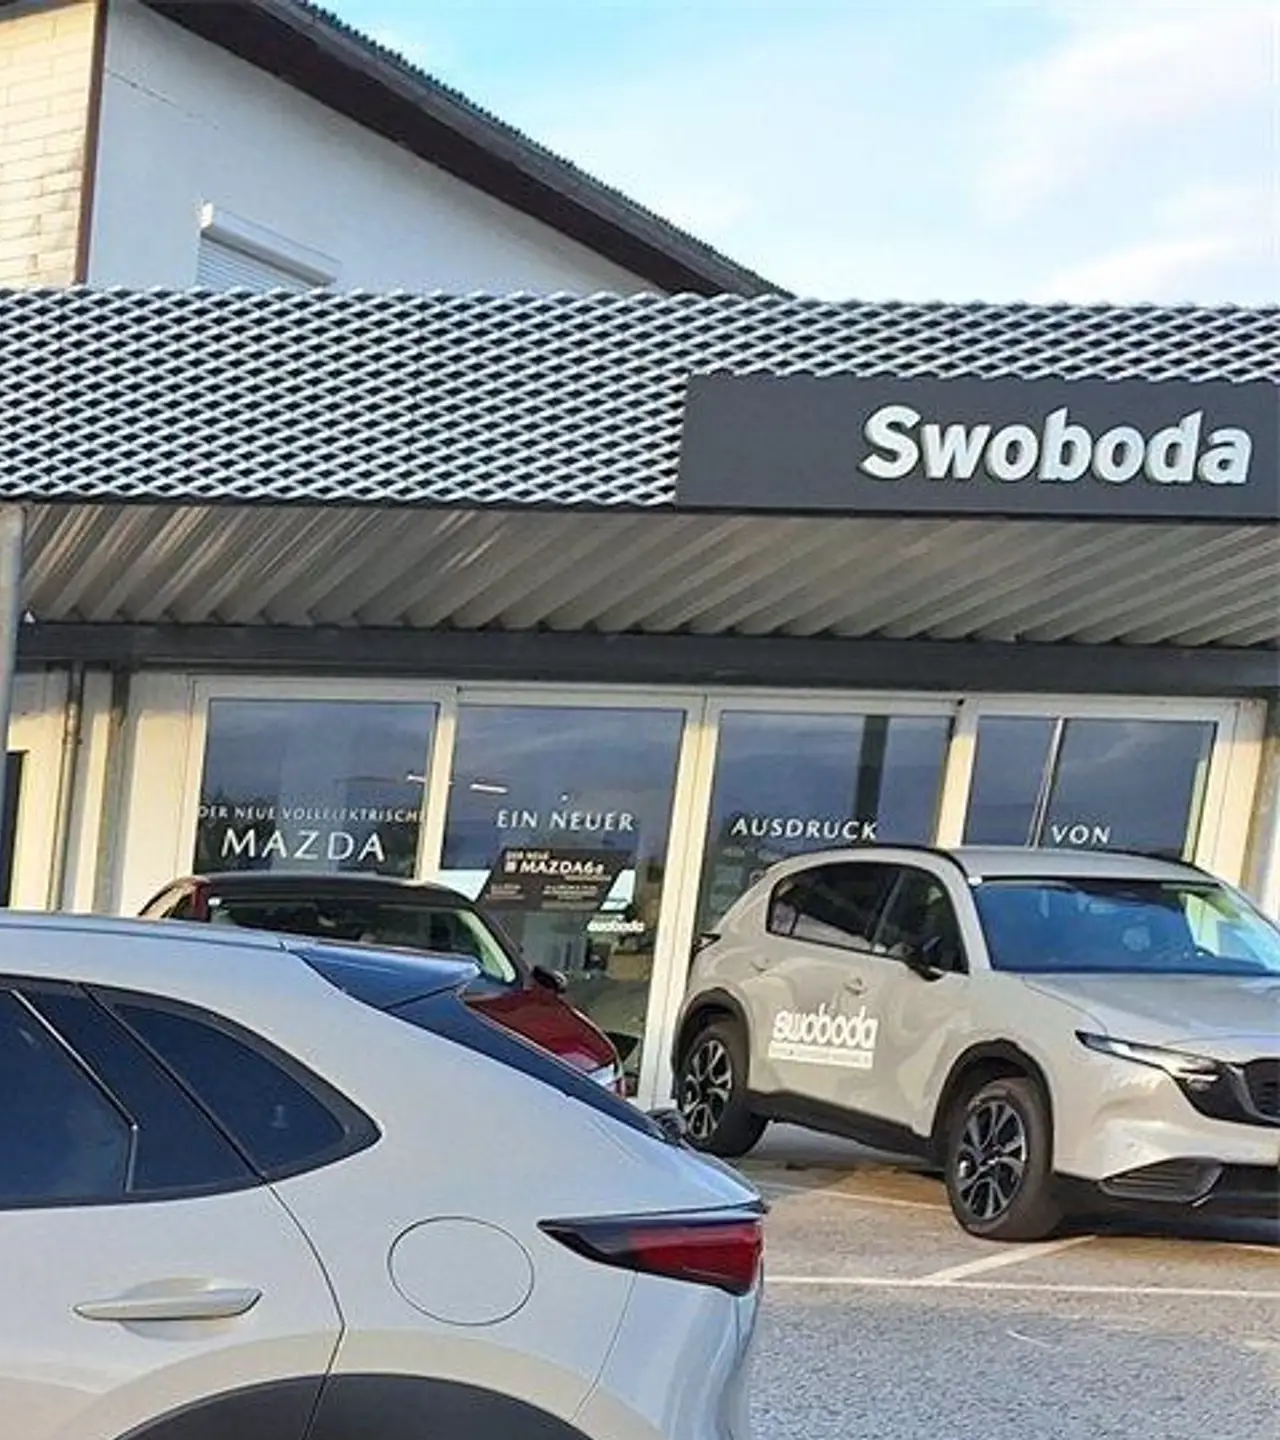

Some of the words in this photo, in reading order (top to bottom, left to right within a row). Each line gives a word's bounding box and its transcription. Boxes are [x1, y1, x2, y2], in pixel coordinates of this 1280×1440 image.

[860, 404, 1253, 485] Swoboda
[496, 809, 538, 829] EIN
[549, 811, 635, 831] NEUER
[730, 817, 878, 841] AUSDRUCK
[1051, 823, 1112, 845] VON
[221, 828, 385, 863] MAZDA
[772, 1002, 879, 1050] swoboda
